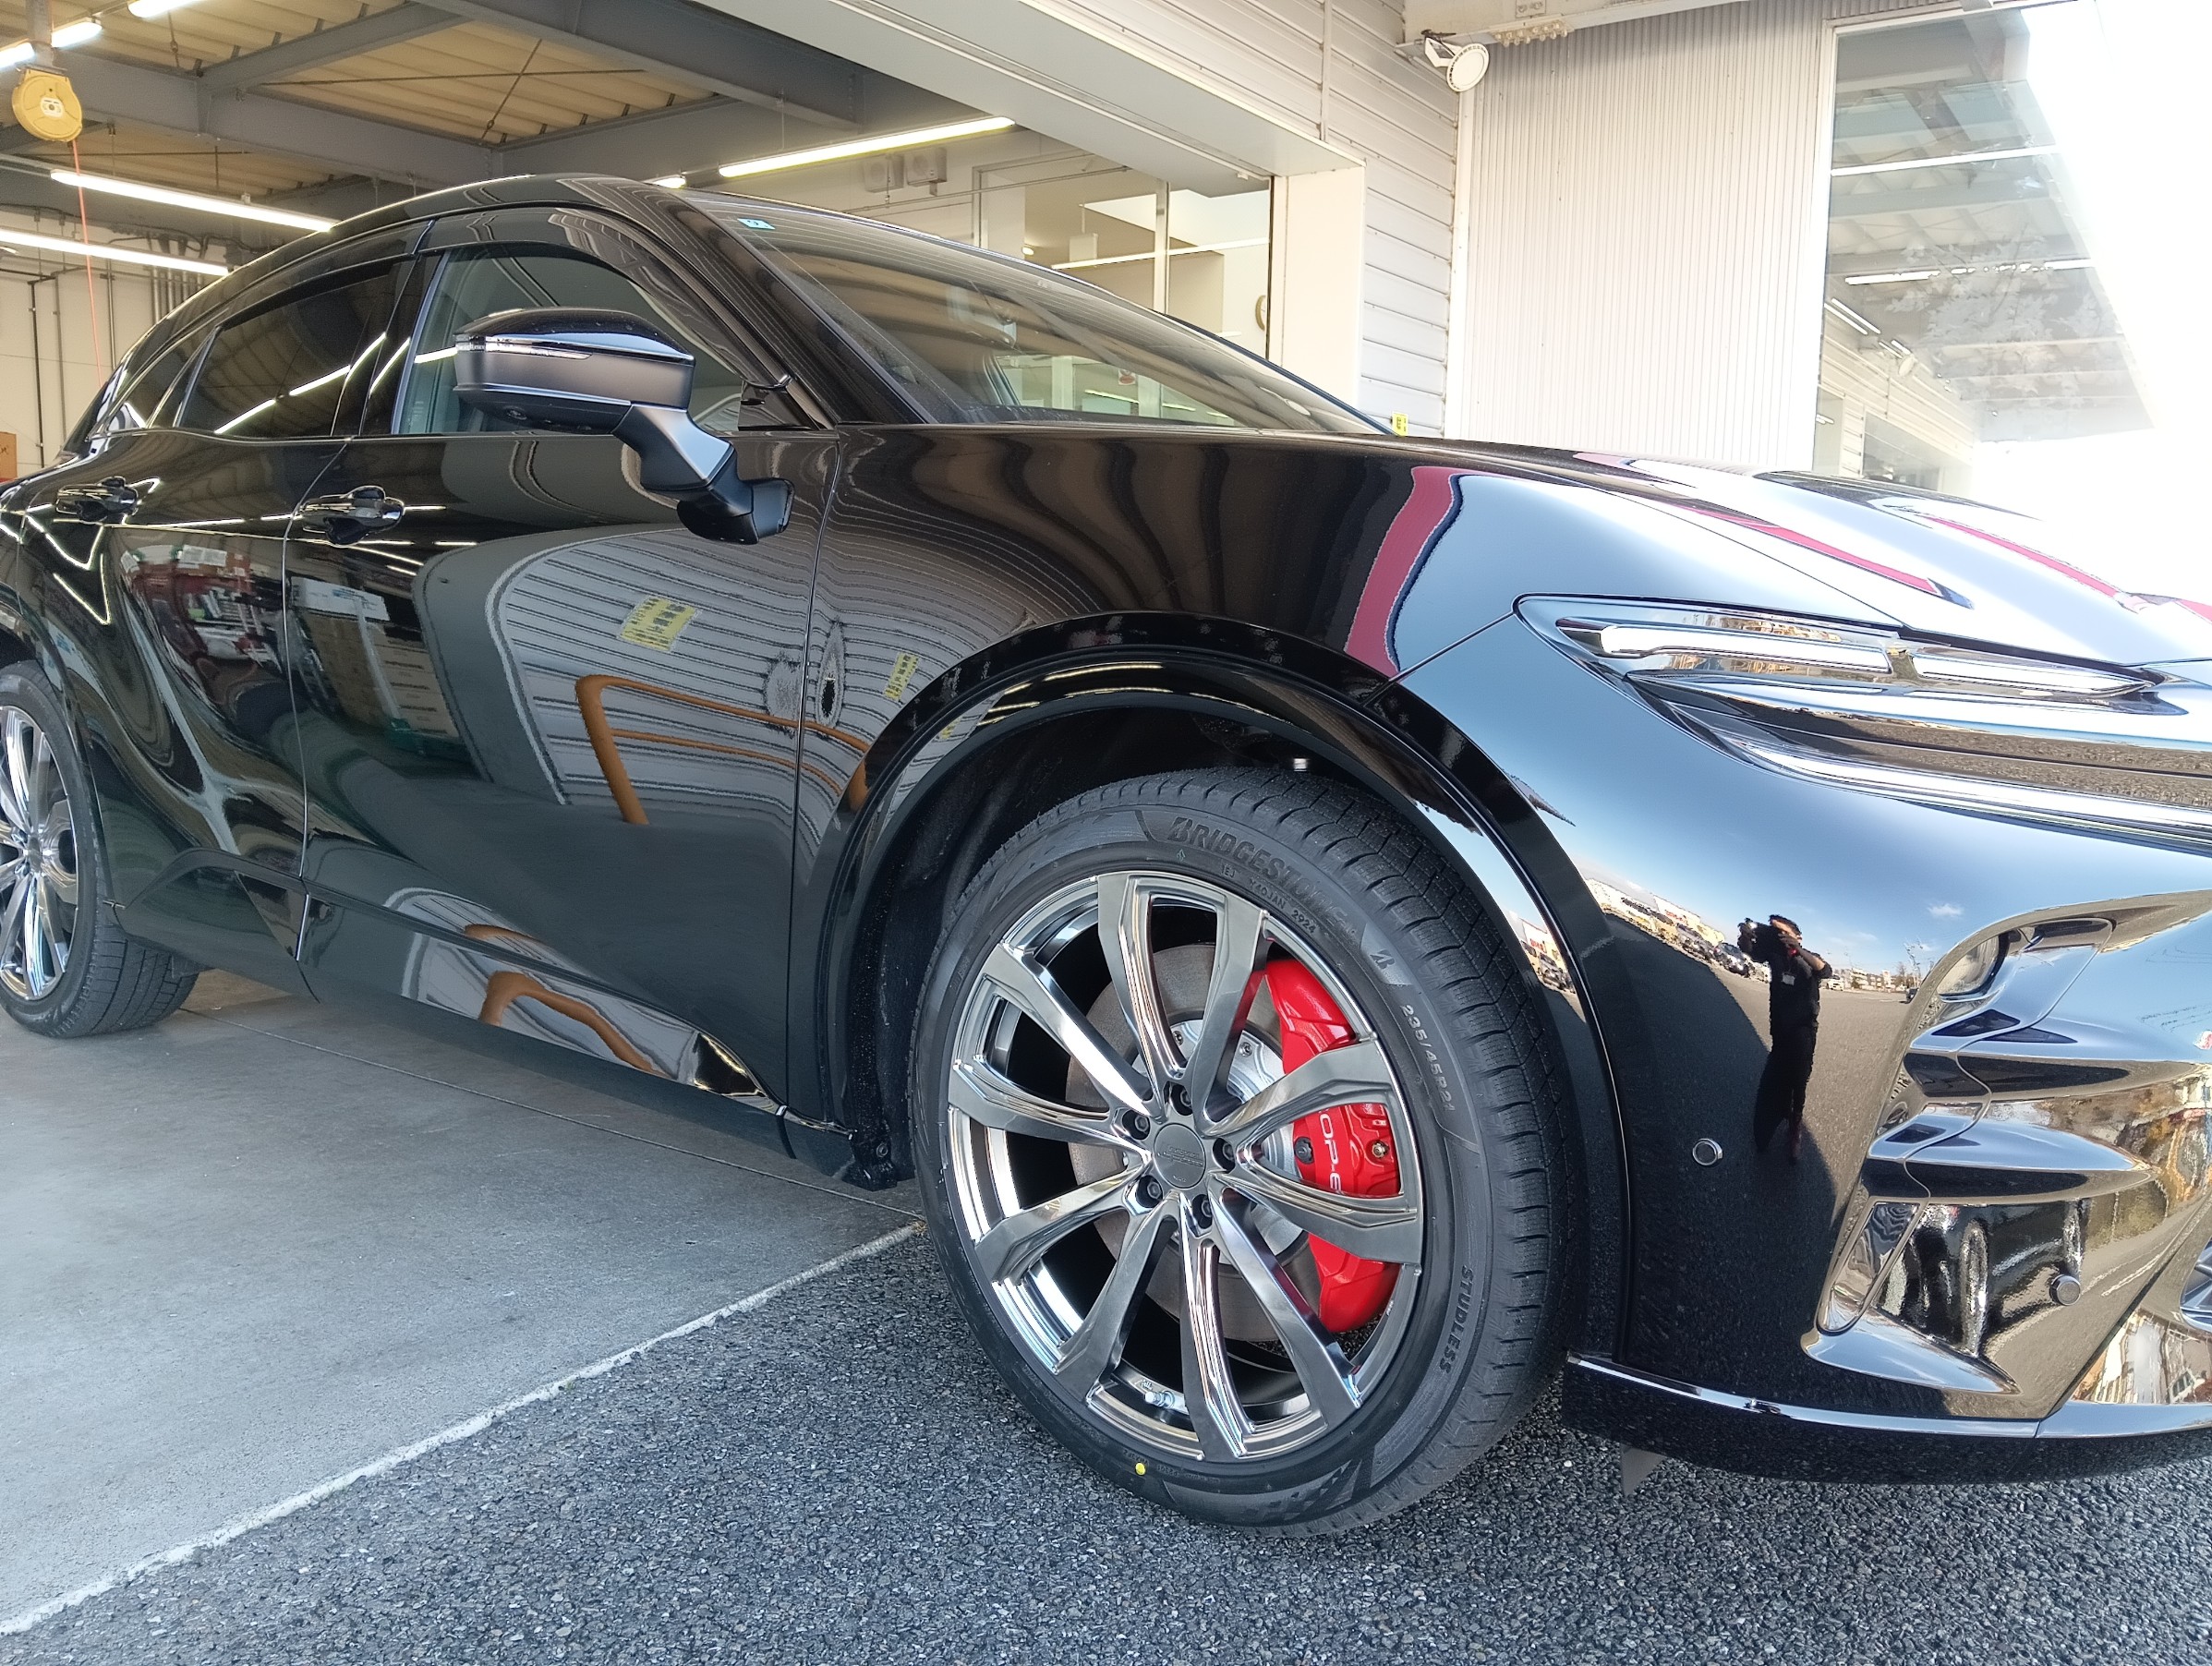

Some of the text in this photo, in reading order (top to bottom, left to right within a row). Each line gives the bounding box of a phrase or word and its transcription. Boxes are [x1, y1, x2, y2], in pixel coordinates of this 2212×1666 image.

[1167, 816, 1349, 927] BRIDGESTONE
[1291, 910, 1316, 934] 2924
[1399, 1004, 1457, 1112] 235/45R21
[1439, 1264, 1474, 1374] STUDLESS
